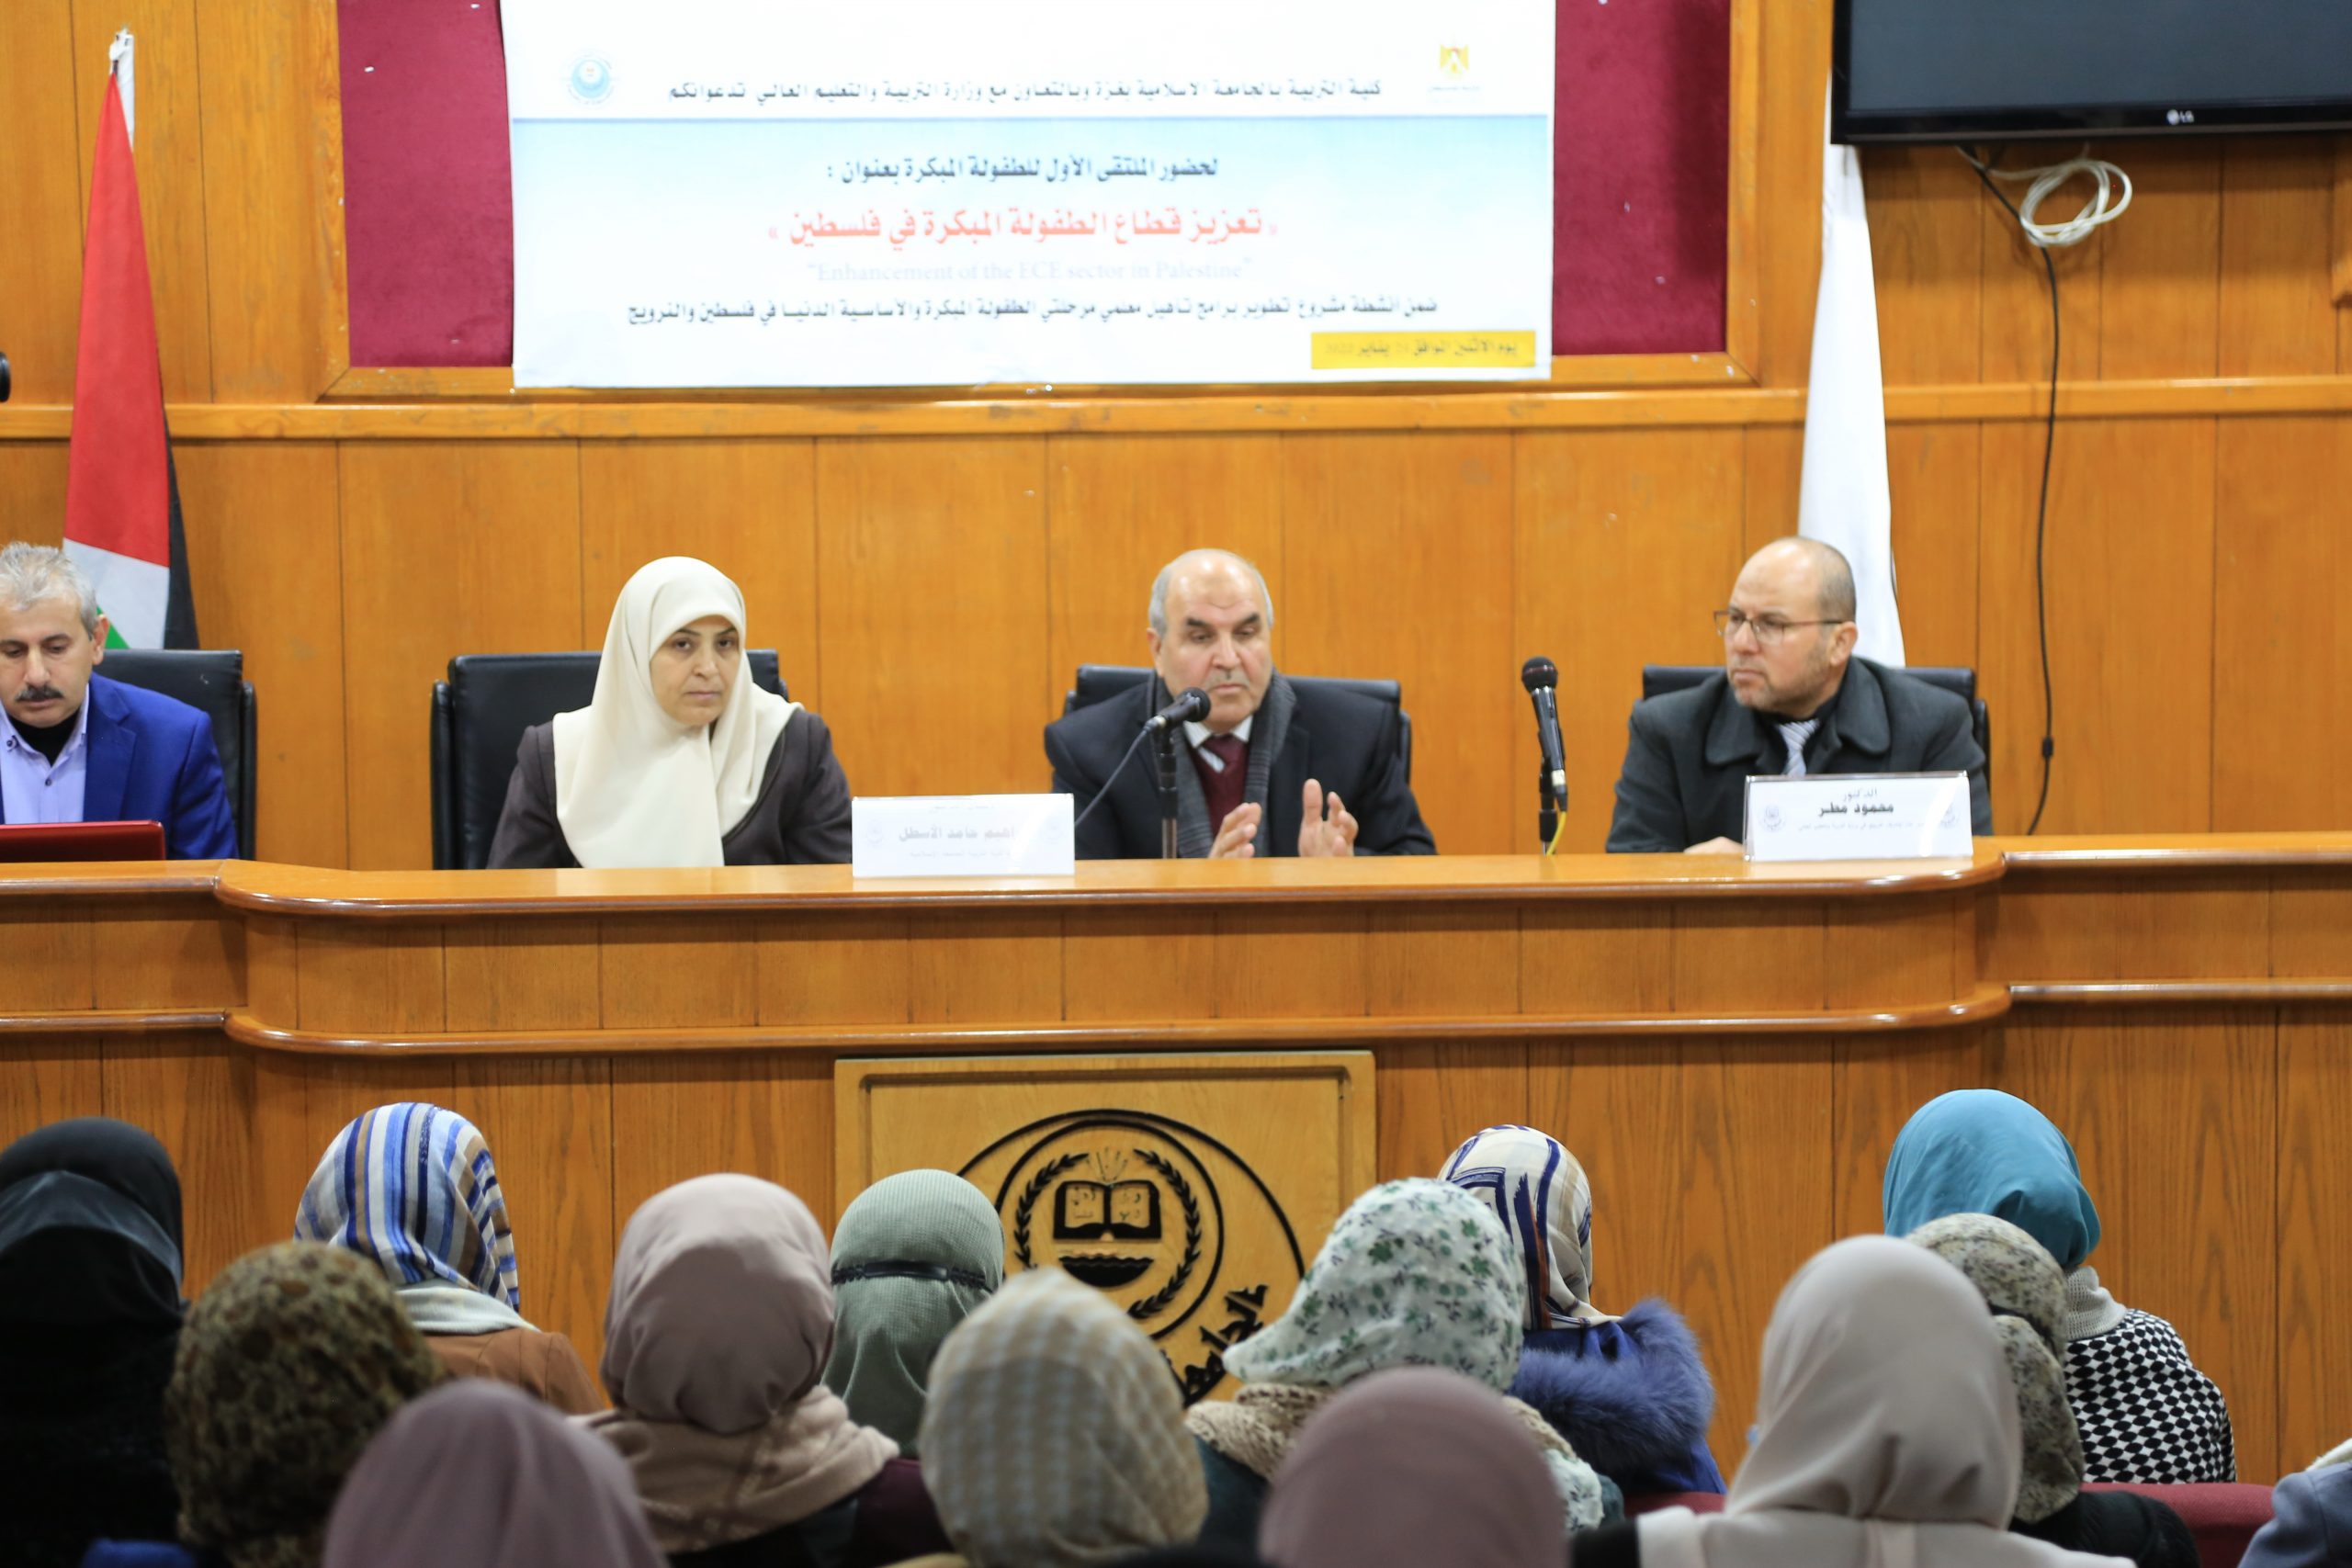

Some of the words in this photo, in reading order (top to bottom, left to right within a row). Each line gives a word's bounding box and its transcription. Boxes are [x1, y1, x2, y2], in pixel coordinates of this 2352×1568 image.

[756, 83, 807, 107] العالي
[814, 82, 876, 103] والتعليم
[884, 80, 938, 103] التربية
[944, 81, 982, 102] وزارة
[988, 85, 1007, 104] مع
[1013, 81, 1090, 102] وبالتعاون
[1094, 80, 1131, 102] بغزة
[1214, 78, 1281, 101] بالجامعة
[1288, 77, 1342, 101] التربية
[842, 158, 899, 185] بعنوان
[904, 157, 963, 184] المبكرة
[967, 155, 1040, 183] للطفولة
[1097, 155, 1155, 183] الملتقى
[1158, 156, 1218, 183] لحضور
[790, 209, 882, 248] فلسطين
[888, 209, 916, 251] في
[921, 210, 1000, 245] المبكرة
[1009, 208, 1107, 243] الطفولة
[1114, 208, 1182, 244] قطاع
[1189, 209, 1261, 245] تعزيز
[956, 262, 978, 280] of
[982, 262, 1013, 280] the
[1018, 261, 1060, 280] ECE
[1067, 264, 1125, 280] sector
[1131, 263, 1150, 279] in
[628, 301, 695, 325] والنرويج
[698, 299, 755, 324] فلسطين
[759, 299, 777, 326] في
[781, 300, 834, 323] الدنيا
[925, 299, 972, 321] المبكرة
[976, 298, 1035, 321] الطفولة
[1041, 298, 1095, 322] مرحلتي
[1101, 303, 1141, 323] معلمي
[1197, 299, 1238, 321] برامج
[1241, 296, 1291, 320] تطوير
[1298, 297, 1345, 319] مشروع
[1403, 296, 1438, 319] ضمن
[1818, 801, 1849, 818] مطر
[1853, 802, 1894, 817] محمود
